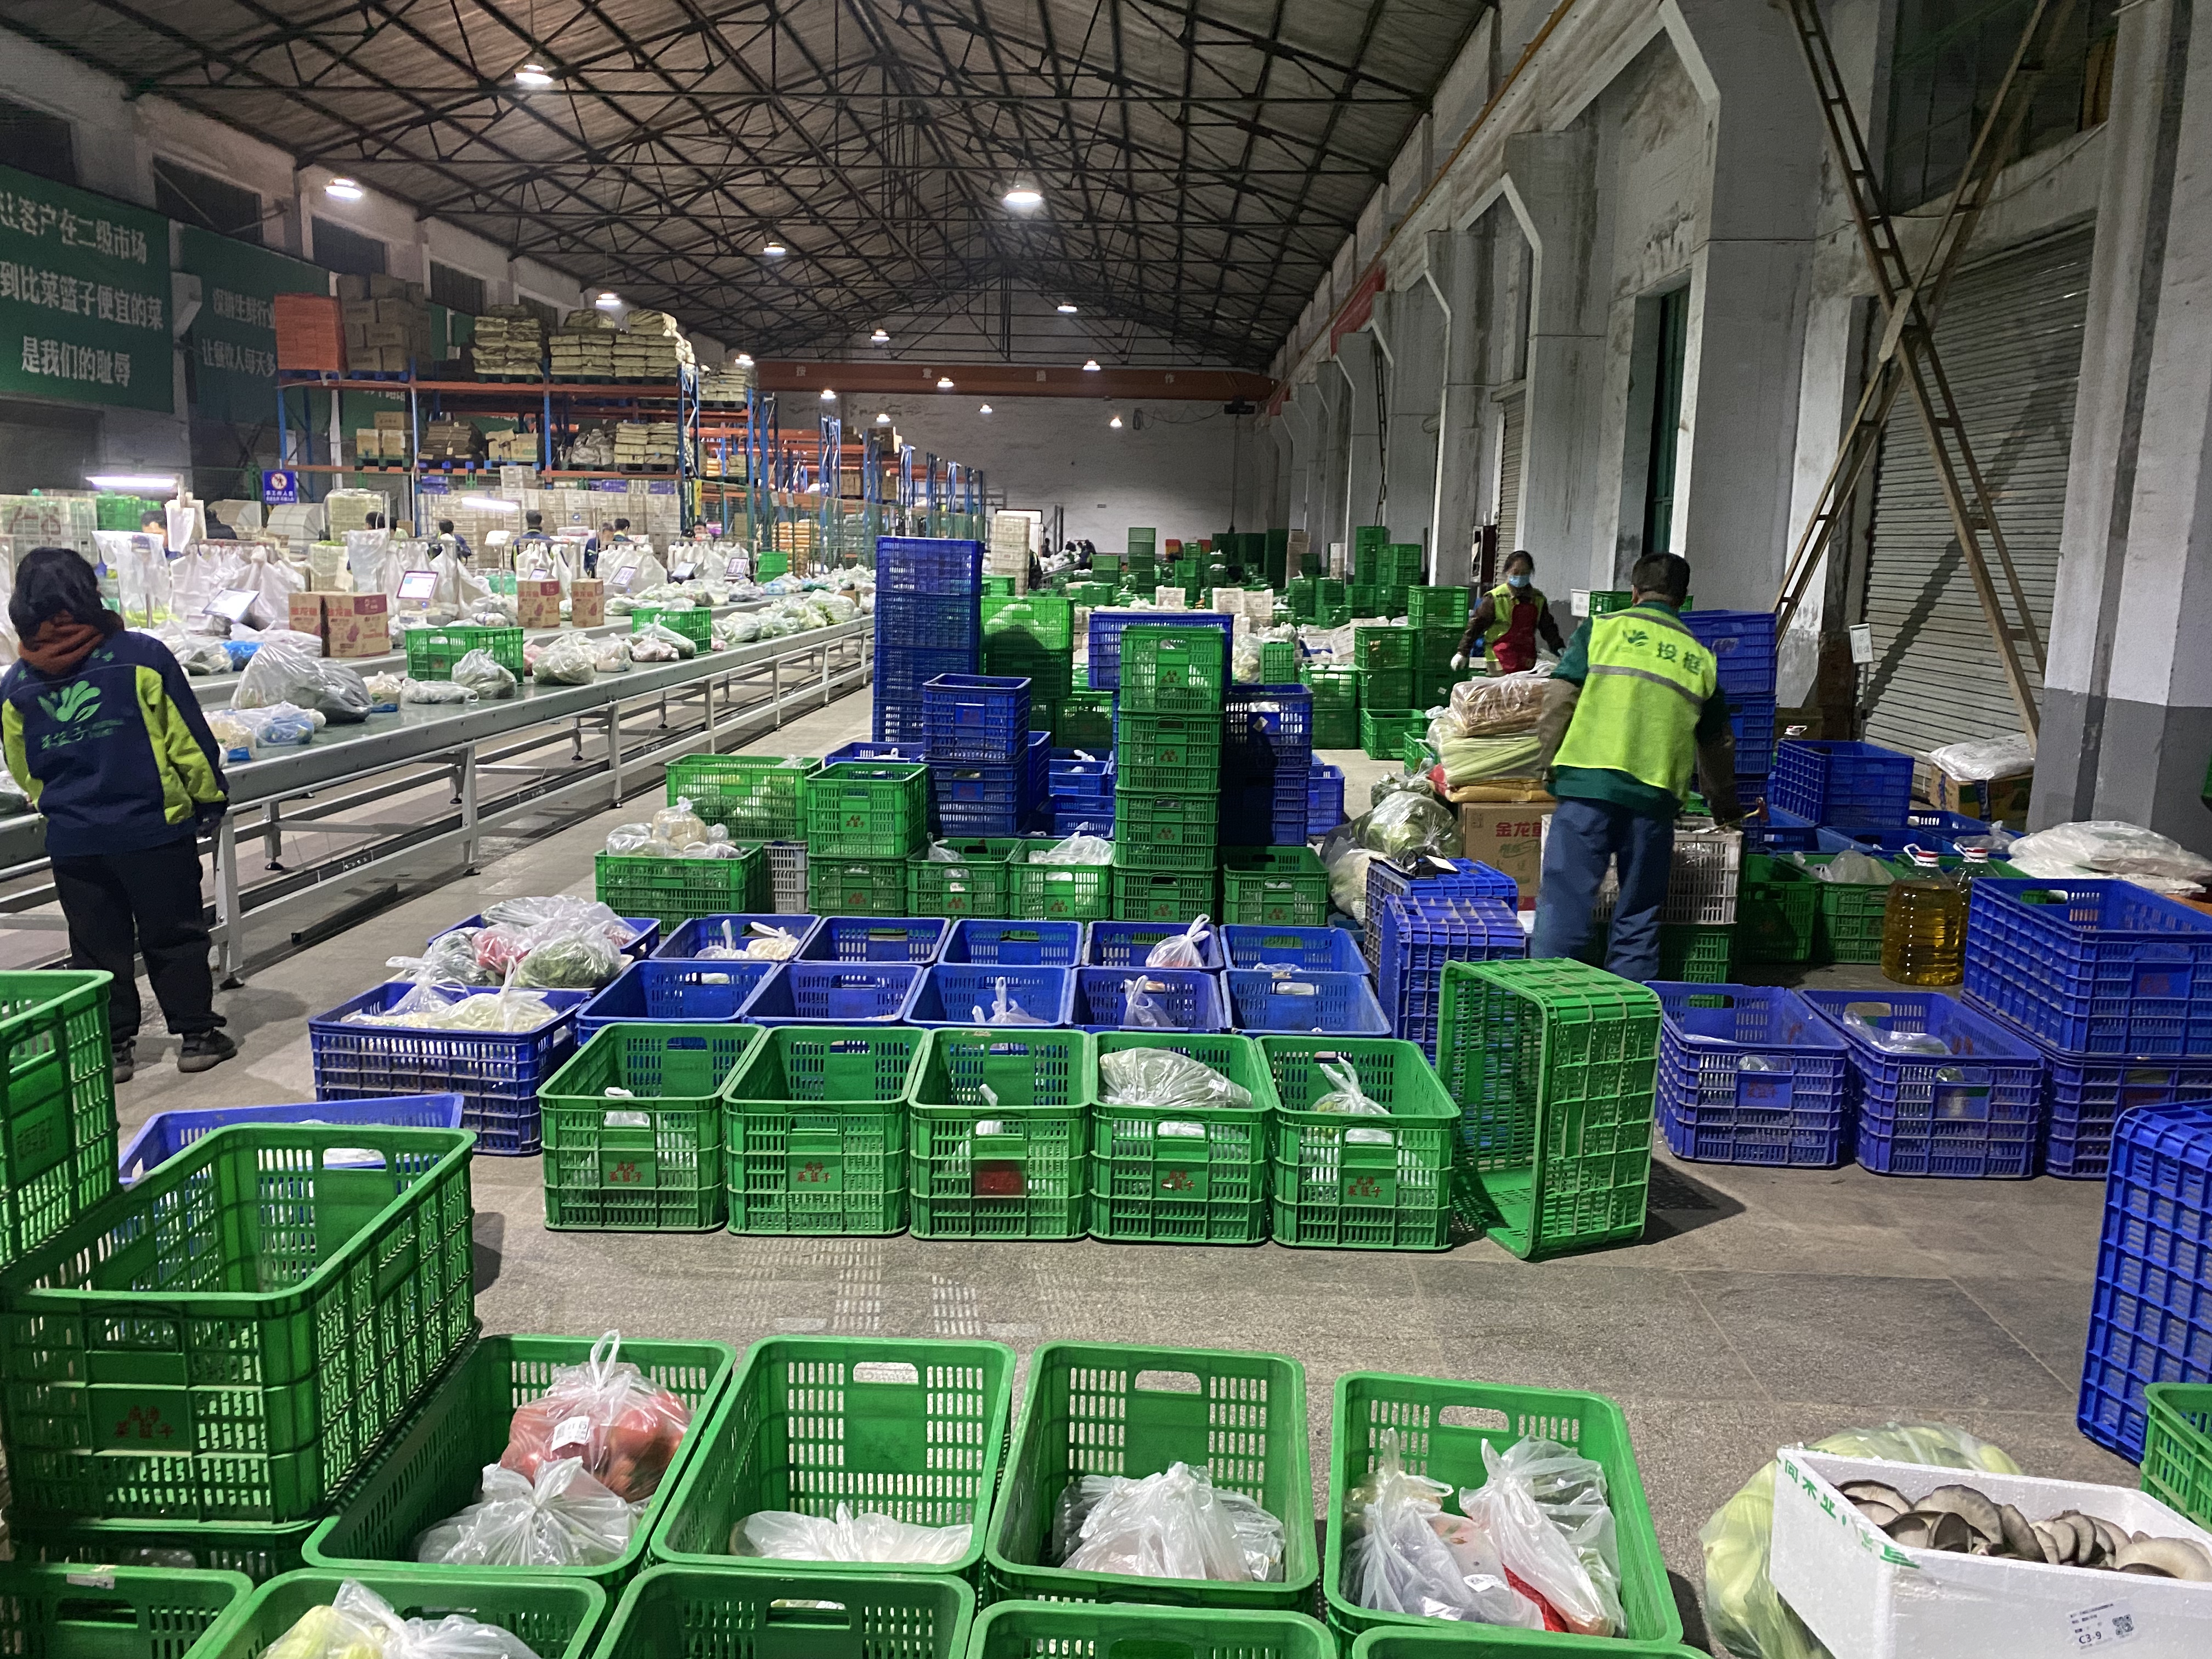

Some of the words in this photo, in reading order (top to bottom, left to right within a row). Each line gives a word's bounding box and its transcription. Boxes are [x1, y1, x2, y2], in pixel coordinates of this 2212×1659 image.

[21, 335, 131, 387] 是我们的耻辱
[2079, 1631, 2102, 1644] C3-9
